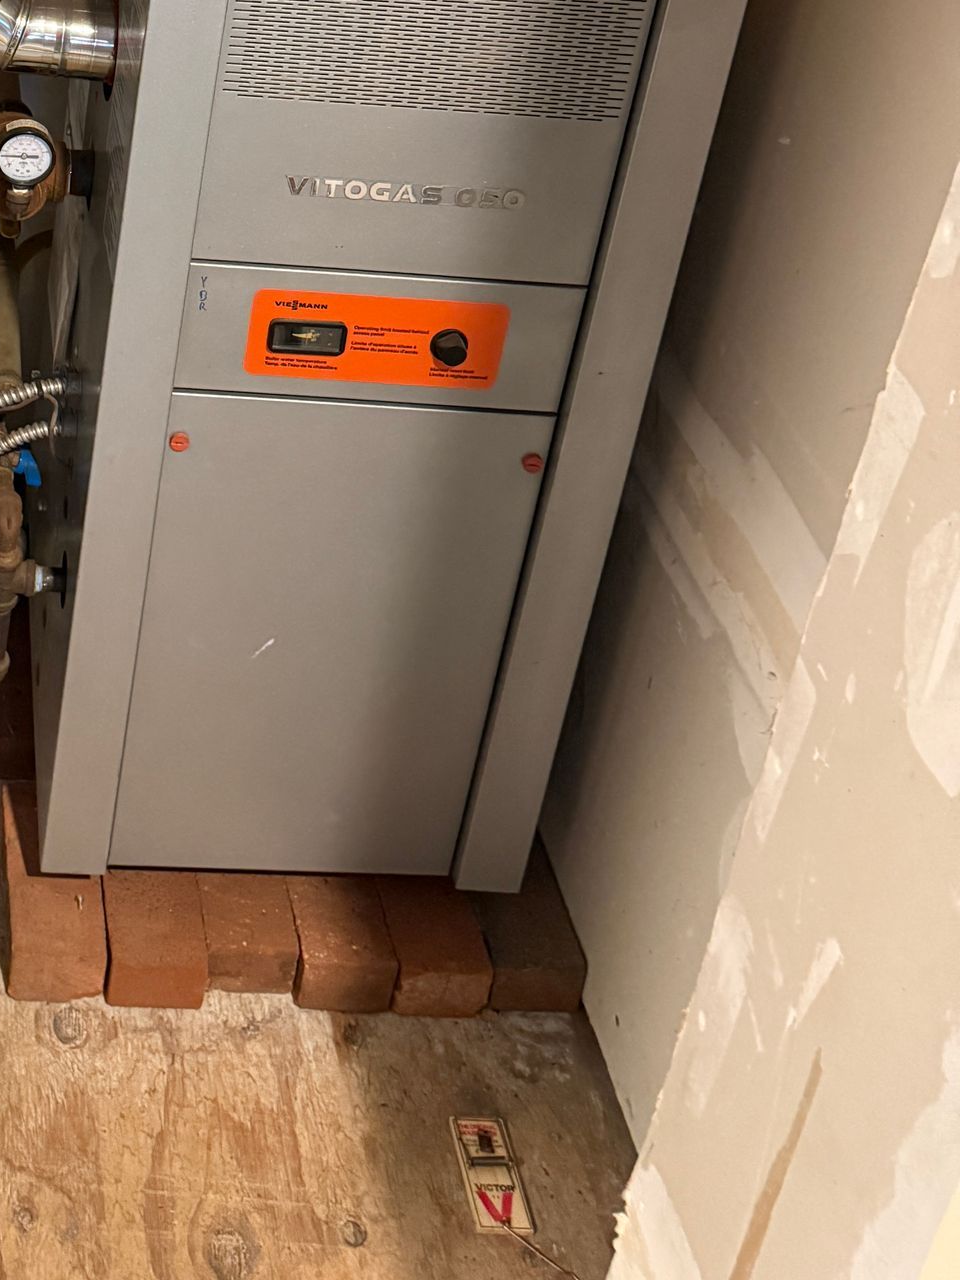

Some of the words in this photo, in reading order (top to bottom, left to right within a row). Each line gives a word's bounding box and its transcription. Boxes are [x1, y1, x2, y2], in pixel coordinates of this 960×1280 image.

[286, 175, 443, 206] VITOGAS
[454, 187, 527, 210] 050
[275, 300, 328, 310] VIESSMANN
[474, 1183, 516, 1192] VICTOR
